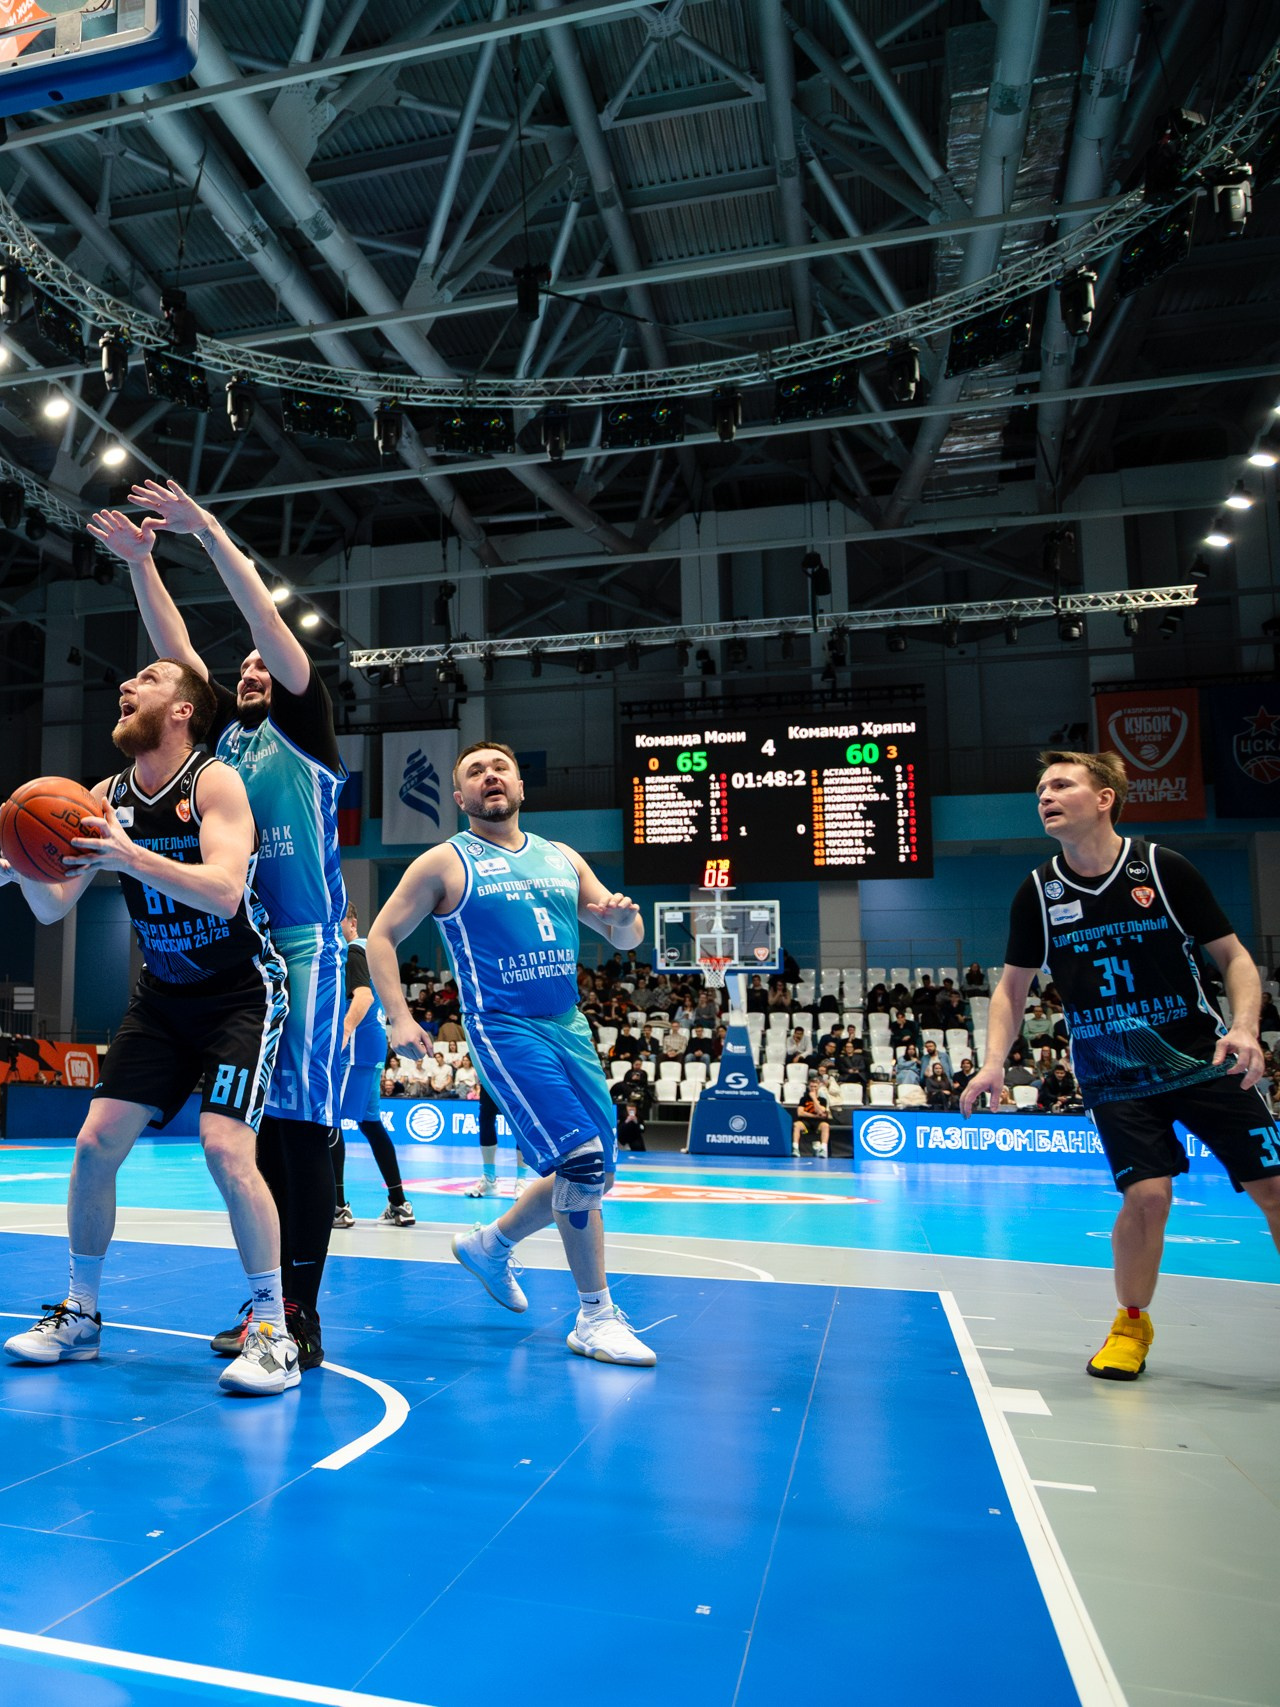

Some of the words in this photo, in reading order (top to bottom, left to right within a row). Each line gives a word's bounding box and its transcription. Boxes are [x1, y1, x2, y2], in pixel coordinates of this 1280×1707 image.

[787, 725, 859, 740] Команда
[861, 721, 917, 737] Хряпы
[1124, 715, 1172, 734] КУБОК
[635, 734, 702, 748] Команда
[704, 730, 747, 744] Мони
[761, 739, 777, 757] 4
[1240, 739, 1280, 755] ЦСК
[648, 757, 660, 771] 0
[676, 751, 709, 773] 65
[846, 742, 880, 764] 60
[886, 745, 898, 759] 3
[731, 769, 808, 790] 01:48:2
[823, 767, 861, 776] АСТАХОВ
[895, 765, 902, 773] 0
[896, 773, 903, 781] 2
[710, 782, 720, 790] 11
[897, 800, 904, 808] 2
[1123, 790, 1188, 804] ЕТЫРЕХ
[711, 808, 721, 816] 11
[898, 809, 909, 817] 12
[710, 825, 717, 833] 9
[739, 826, 748, 837] 1
[796, 824, 806, 835] 0
[898, 827, 905, 835] 4
[898, 836, 905, 844] 2
[899, 845, 910, 853] 11
[259, 841, 295, 860] 25/26
[704, 869, 729, 887] 06
[506, 888, 566, 901] МАТЧ
[532, 907, 557, 942] 8
[195, 927, 231, 948] 25/26
[1073, 934, 1144, 954] МАТЧ
[498, 949, 576, 970] ГАЗПРОМБ
[501, 967, 538, 985] КУБОК
[1093, 956, 1136, 997] 34
[1072, 994, 1187, 1026] АЗПРОМБАН
[1151, 1007, 1189, 1026] 25/26
[210, 1063, 249, 1109] 81
[265, 1069, 297, 1111] 63
[706, 1134, 770, 1146] ГАЗПРОМБАНК
[916, 1125, 1105, 1155] ГАЗПРОМБАНК
